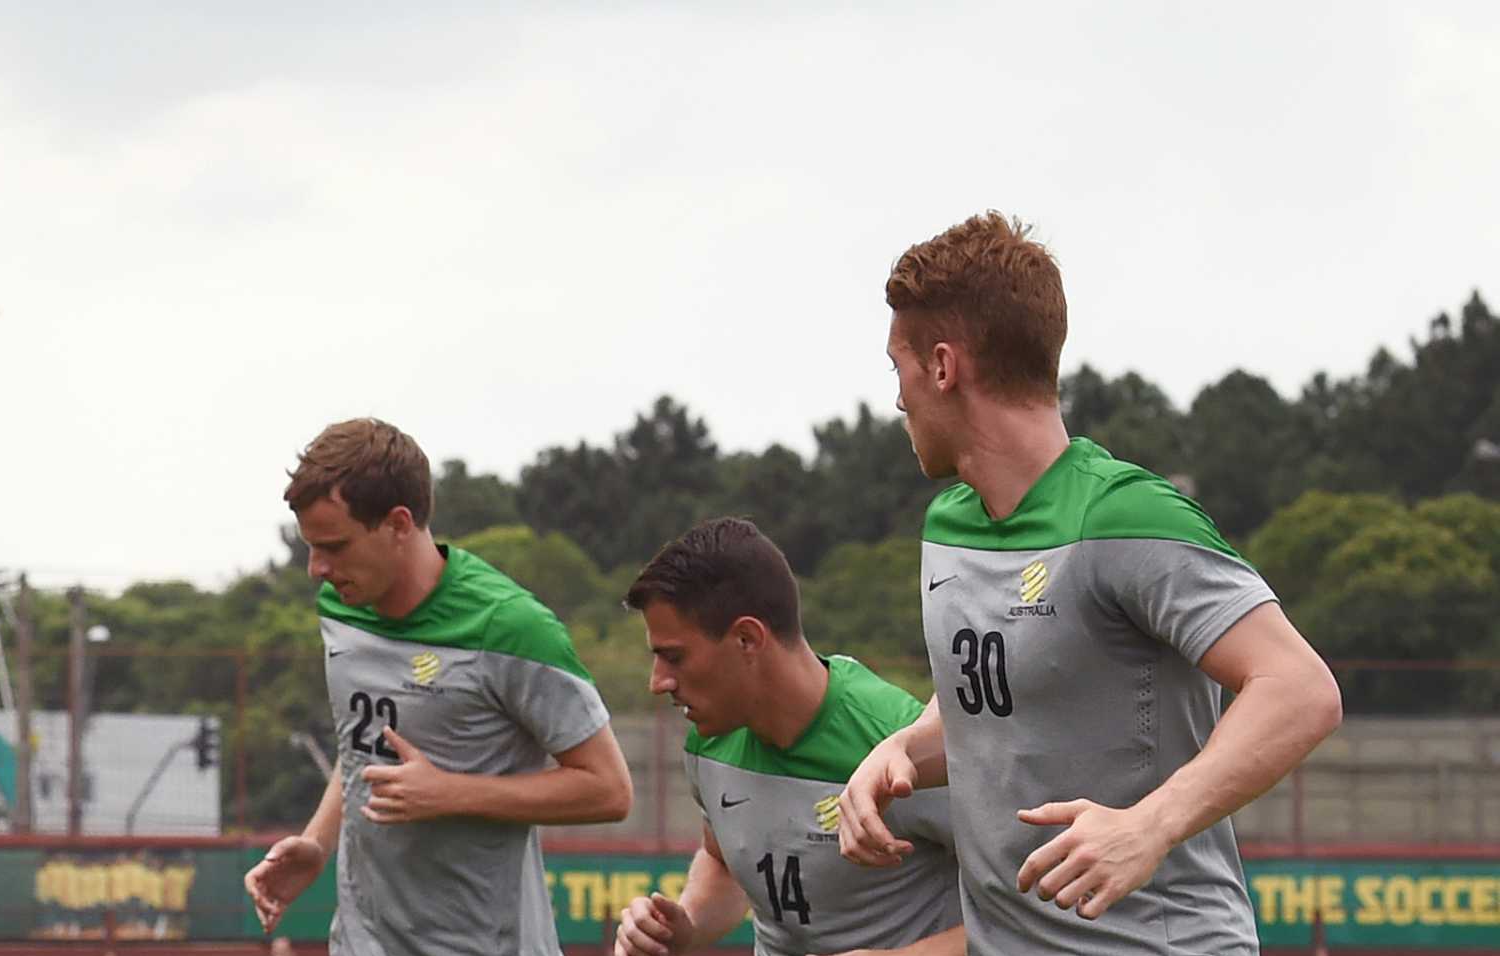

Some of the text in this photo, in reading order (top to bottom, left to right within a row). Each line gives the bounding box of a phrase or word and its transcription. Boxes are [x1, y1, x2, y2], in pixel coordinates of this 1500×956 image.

[1008, 605, 1057, 617] AUSTRALIA
[952, 628, 1013, 718] 30
[350, 692, 400, 759] 22
[757, 852, 811, 925] 14
[1252, 874, 1346, 925] THE
